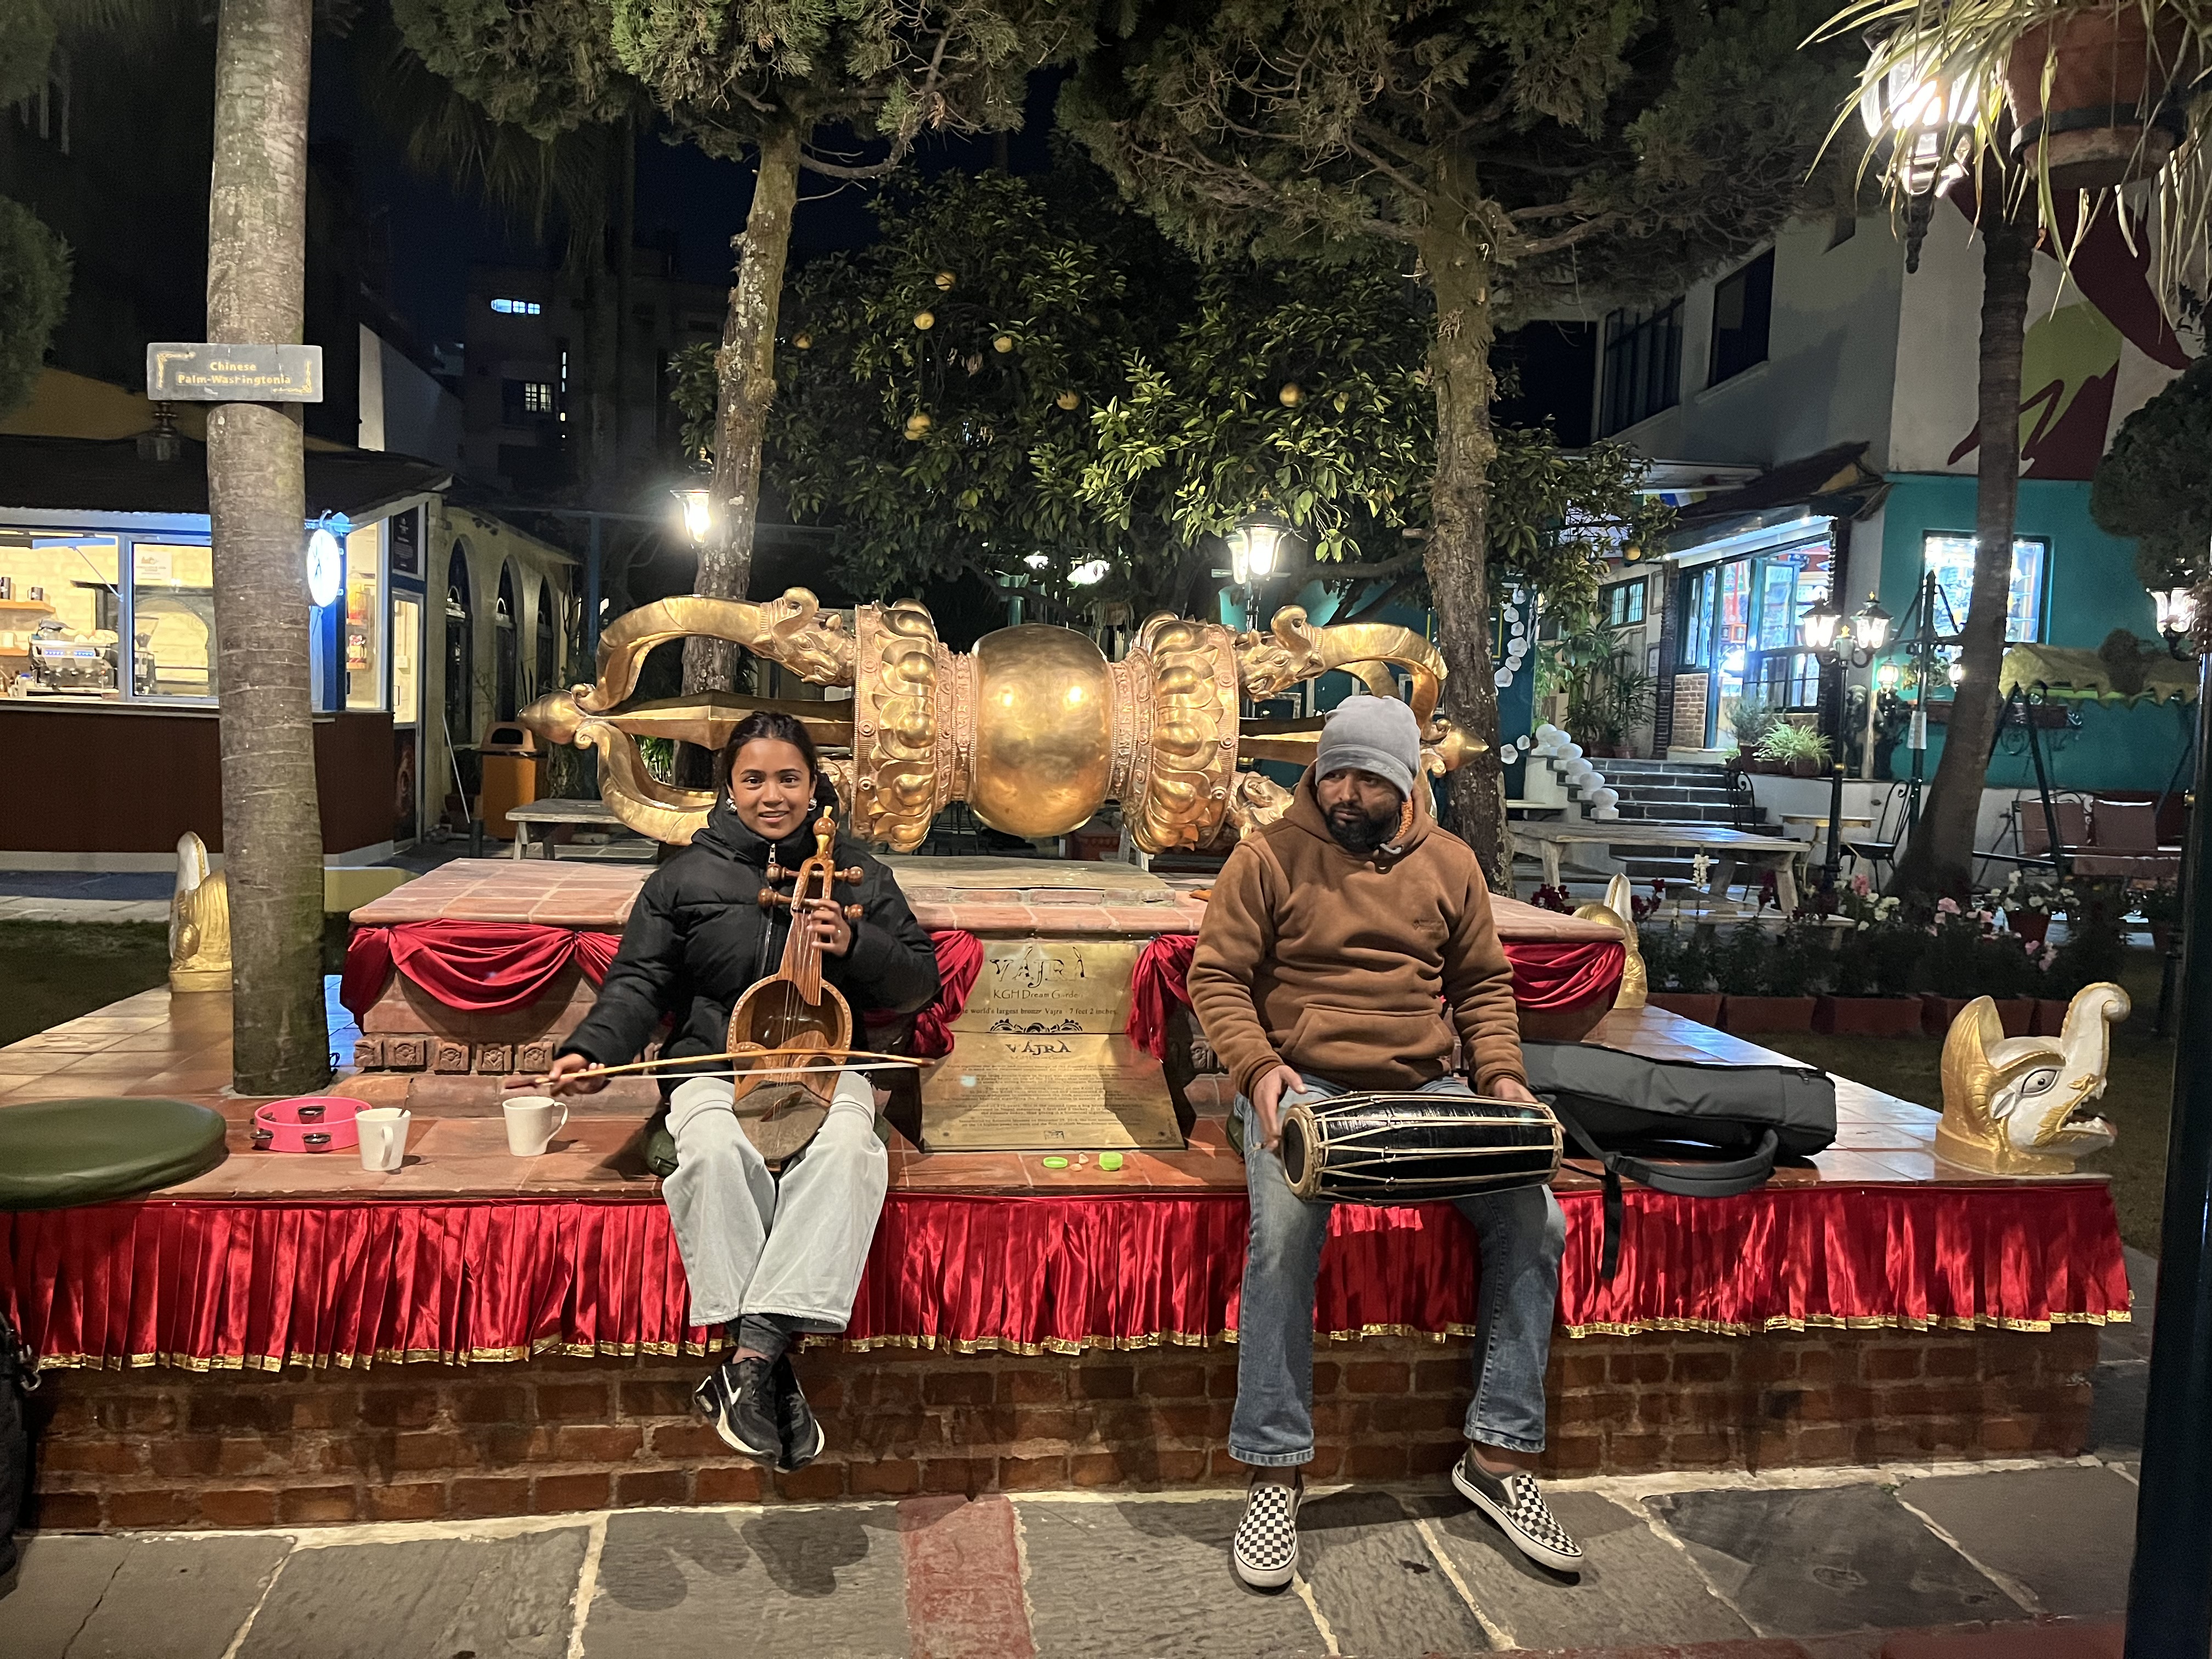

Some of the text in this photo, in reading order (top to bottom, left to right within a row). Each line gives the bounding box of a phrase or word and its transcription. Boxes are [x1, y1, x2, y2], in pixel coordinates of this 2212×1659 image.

[210, 362, 257, 371] Chinese
[994, 989, 1019, 999] KGH
[1022, 989, 1049, 999] Dream
[996, 1007, 1018, 1015] largest
[1045, 1008, 1062, 1016] Vajra
